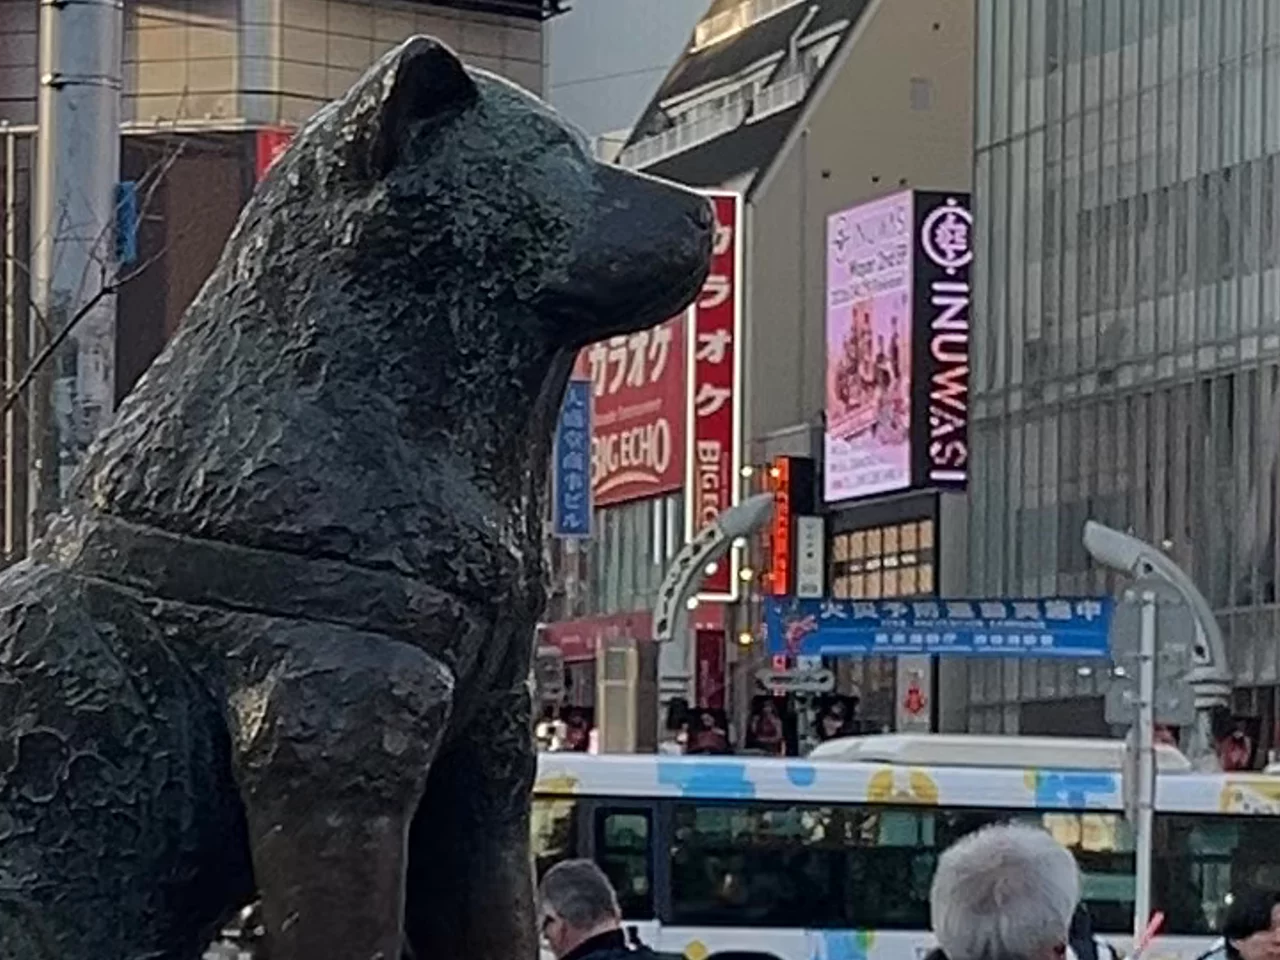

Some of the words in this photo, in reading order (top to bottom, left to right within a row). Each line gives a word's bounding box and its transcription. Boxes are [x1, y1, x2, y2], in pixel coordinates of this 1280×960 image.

[588, 325, 669, 397] カラオケ
[591, 433, 618, 487] BIG
[622, 418, 670, 474] ECHO
[696, 439, 722, 490] BIG
